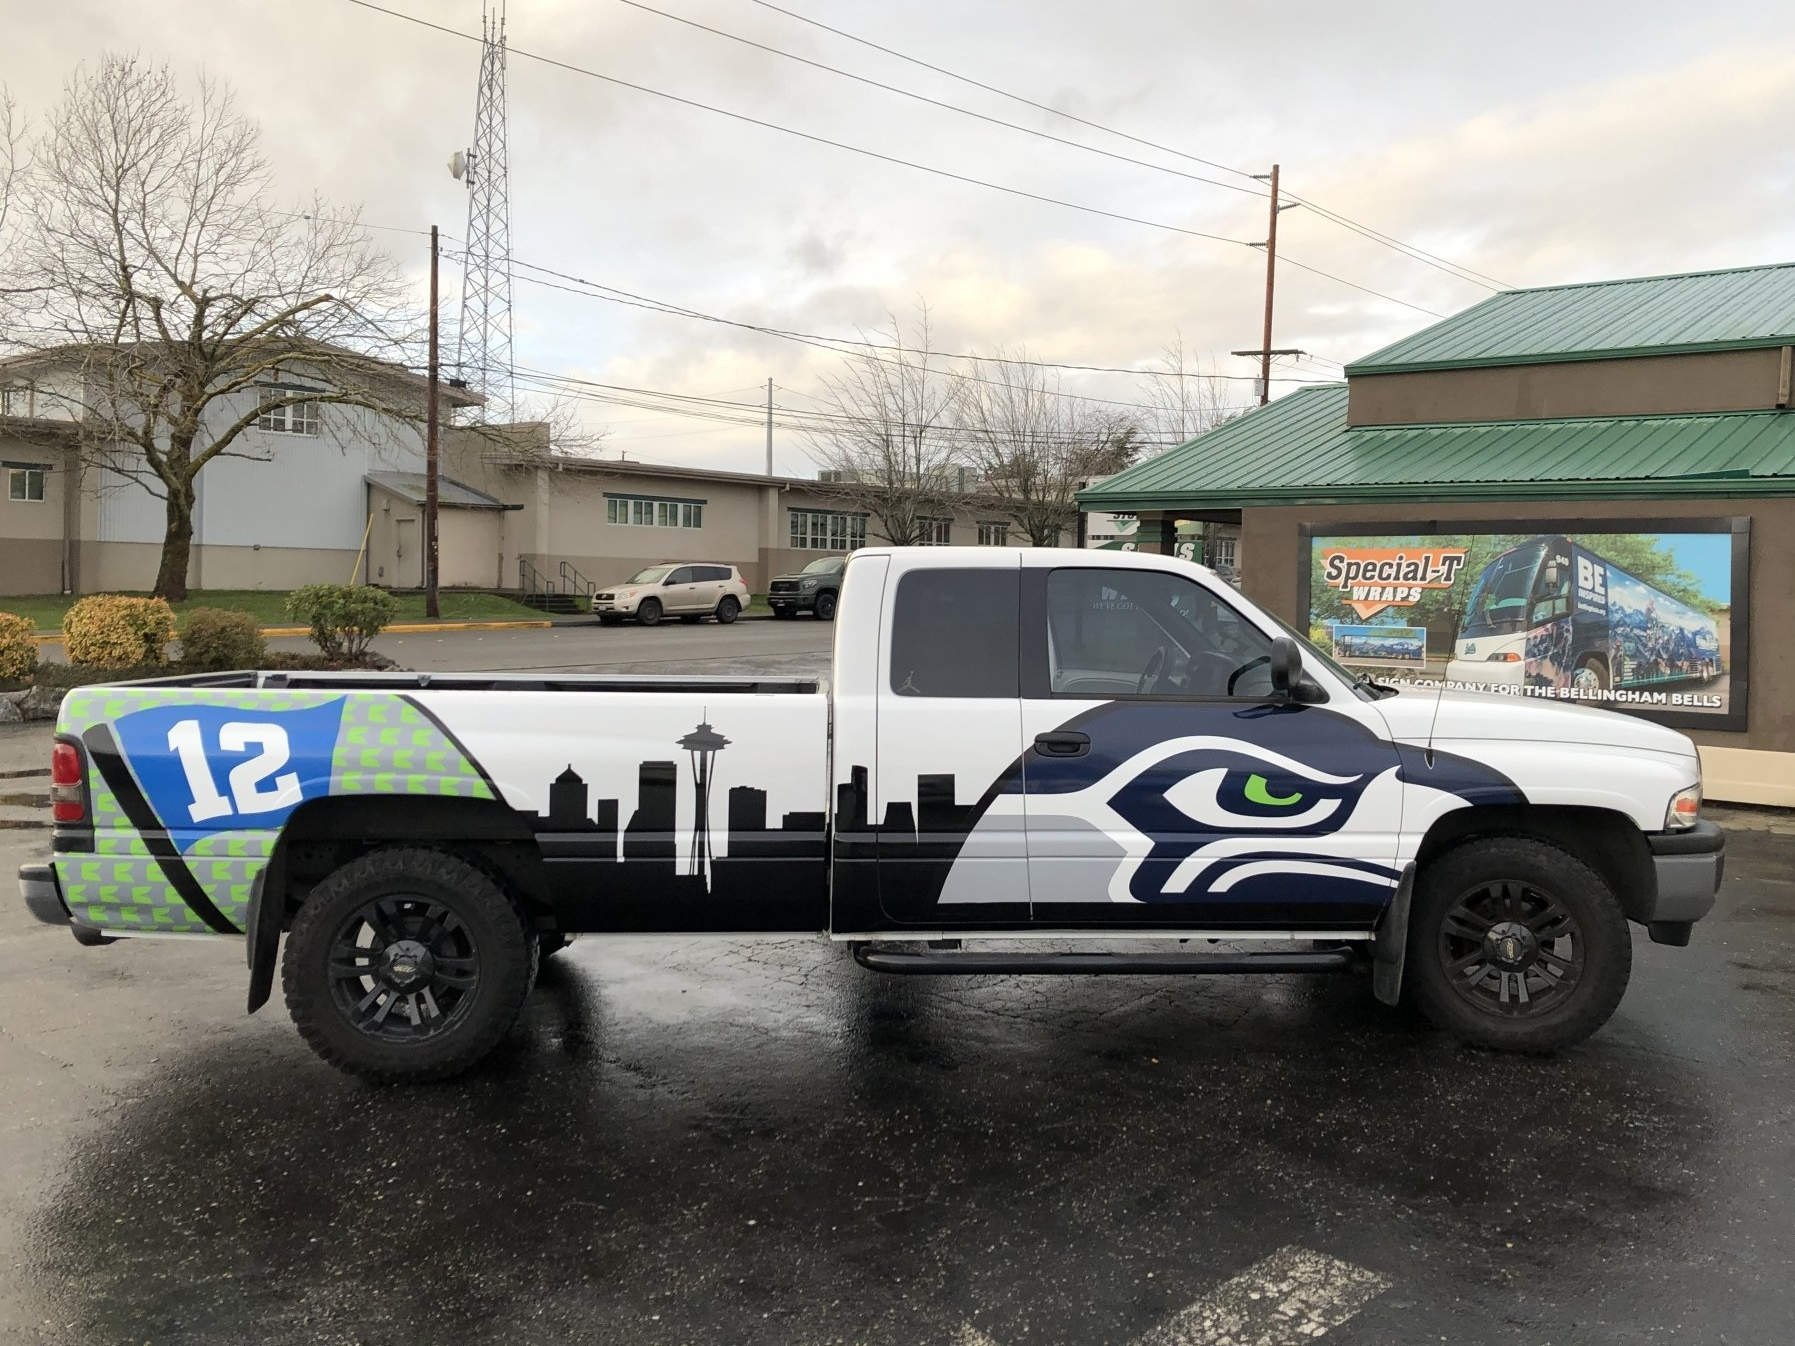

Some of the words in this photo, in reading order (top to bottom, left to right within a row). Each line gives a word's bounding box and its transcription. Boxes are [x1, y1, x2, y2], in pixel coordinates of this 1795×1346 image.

[1325, 553, 1463, 590] Special-T
[1578, 556, 1606, 594] BE
[1352, 586, 1422, 602] WRAPS
[1413, 679, 1487, 692] COMPANY
[1490, 683, 1521, 696] FOR
[1524, 685, 1556, 698] THE
[1560, 687, 1667, 705] BELLINGHAM
[1671, 692, 1722, 708] BELLS
[168, 720, 303, 823] 12
